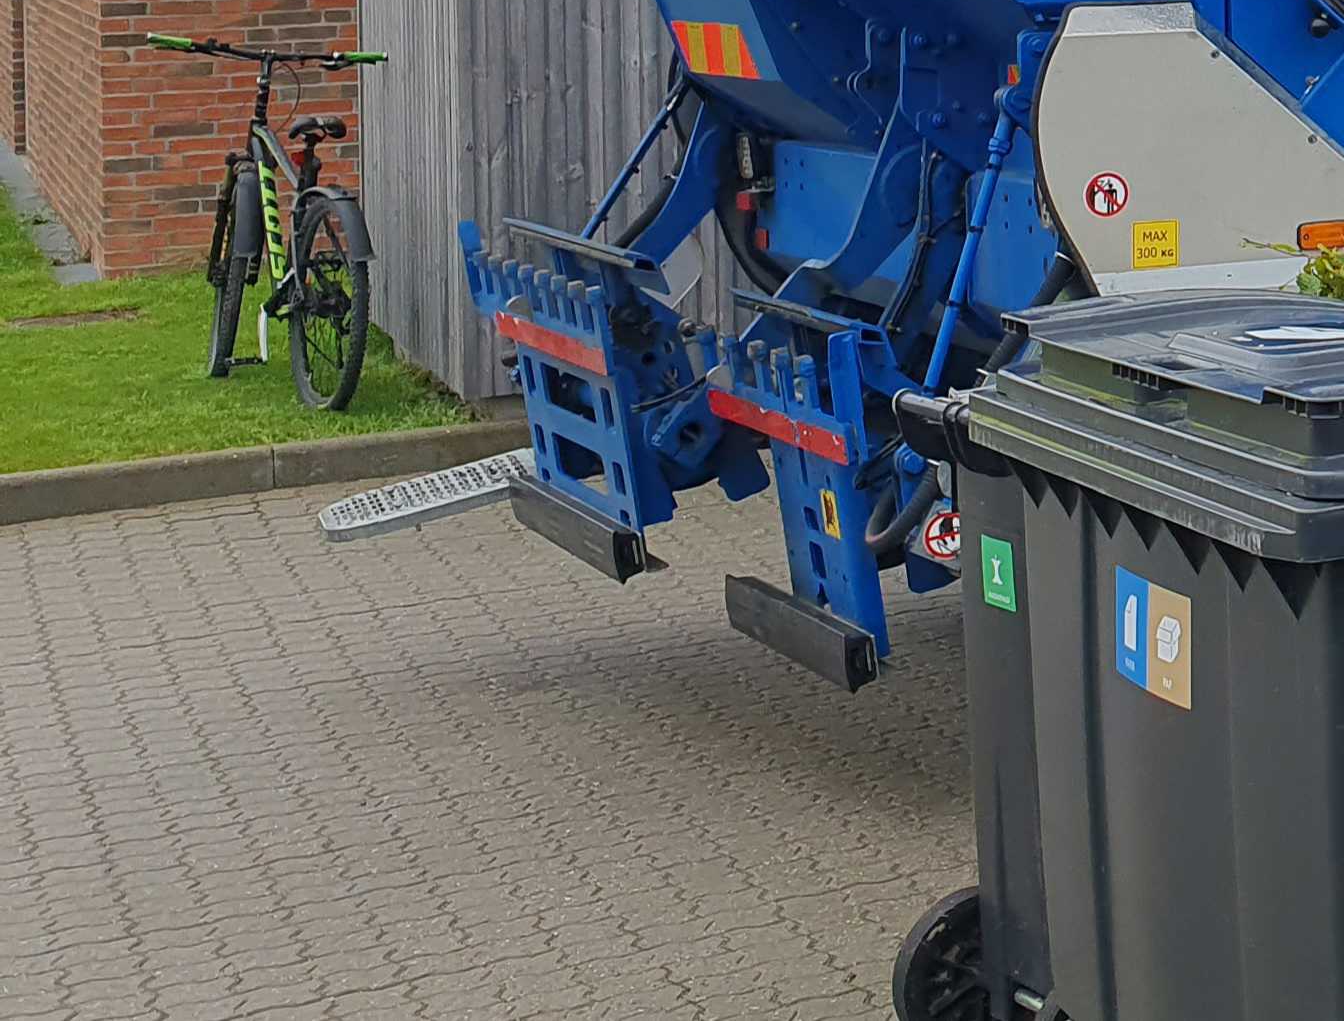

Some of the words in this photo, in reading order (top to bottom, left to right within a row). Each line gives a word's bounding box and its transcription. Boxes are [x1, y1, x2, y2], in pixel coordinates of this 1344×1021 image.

[257, 160, 286, 280] SCOTT
[1142, 230, 1168, 242] MAX
[1136, 247, 1157, 259] 300
